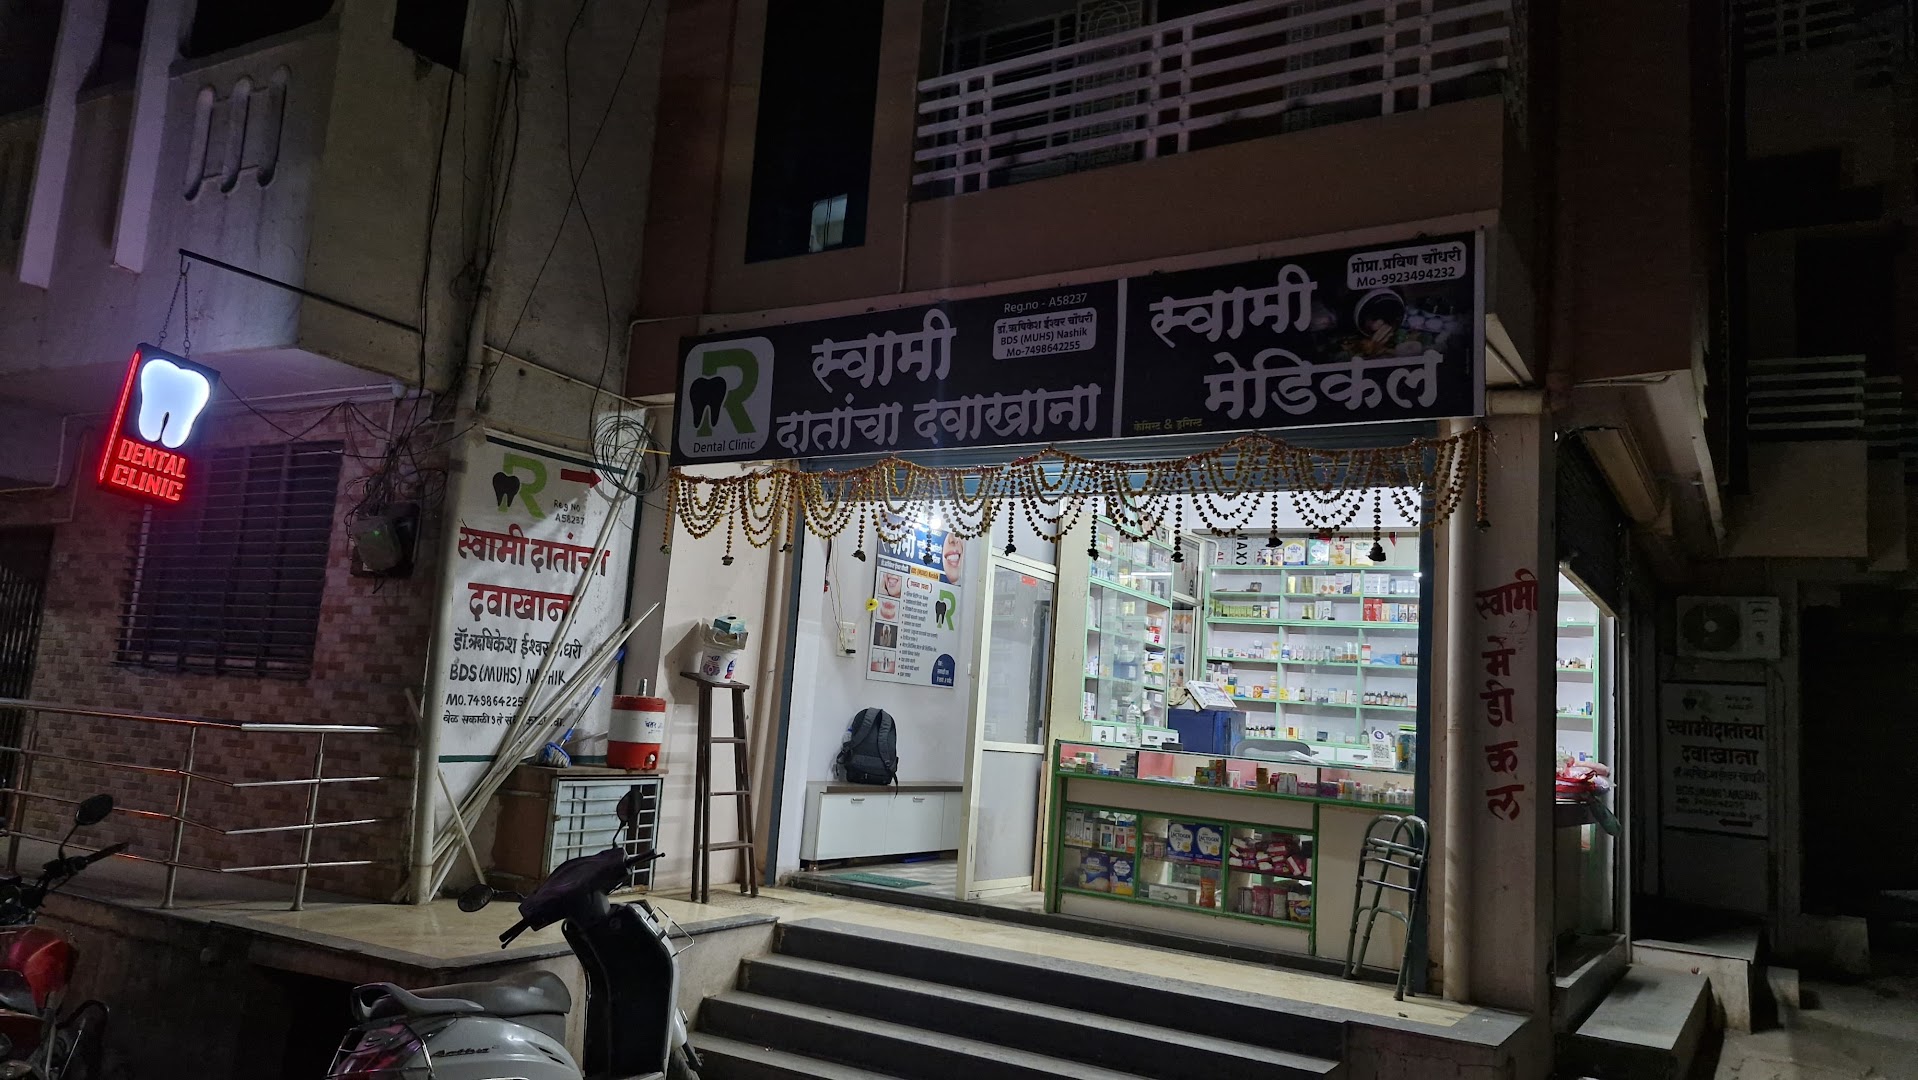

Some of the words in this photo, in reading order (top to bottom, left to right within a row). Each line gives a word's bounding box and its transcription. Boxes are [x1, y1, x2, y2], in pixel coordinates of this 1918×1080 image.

[1356, 267, 1455, 288] Mo-9923494232
[1048, 293, 1088, 308] A58237
[1149, 263, 1318, 348] स्वामी
[811, 308, 957, 393] स्वामी
[1000, 336, 1018, 346] BDS
[1020, 331, 1055, 345] (MUHS)
[1056, 327, 1088, 339] Nashik
[1006, 340, 1081, 357] Mo-7498642255
[1204, 348, 1443, 420] मेडिकल
[776, 392, 903, 455] दातांचा
[913, 382, 1101, 449] दवाखाना
[1163, 418, 1173, 430] &
[118, 439, 186, 478] DENTAL
[693, 439, 726, 454] Dental
[727, 437, 756, 452] Clinic
[111, 464, 184, 501] CLINIC
[555, 513, 585, 525] A58237
[457, 523, 529, 567] स्वामी
